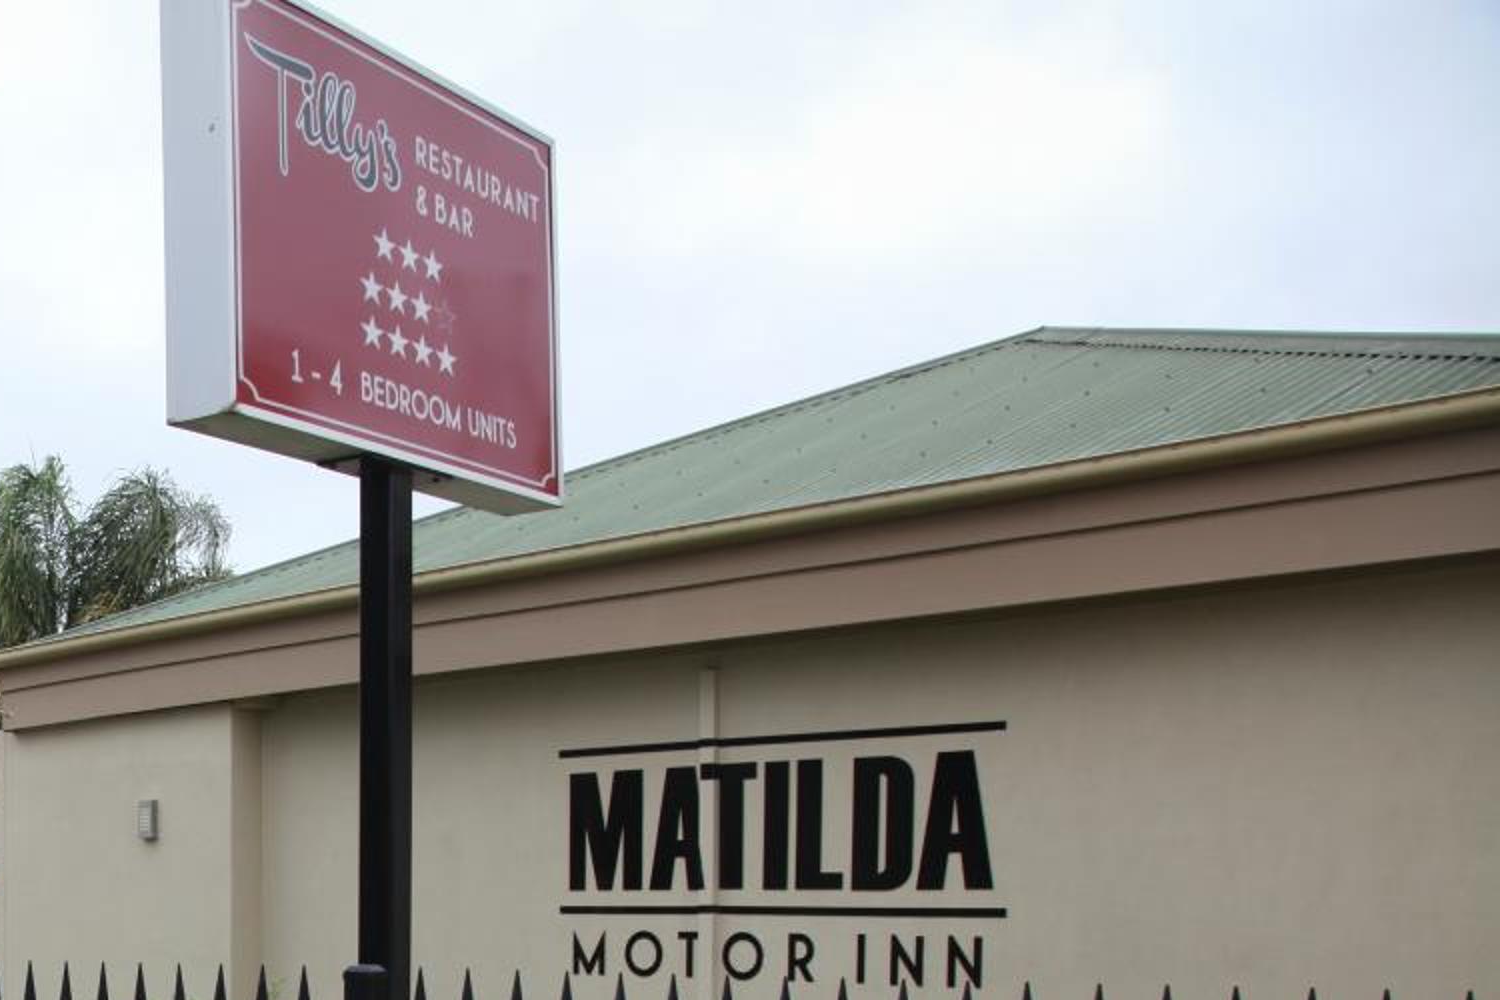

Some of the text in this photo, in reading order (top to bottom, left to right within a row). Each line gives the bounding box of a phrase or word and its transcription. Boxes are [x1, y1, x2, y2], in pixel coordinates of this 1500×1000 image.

[243, 33, 401, 192] Tilly's
[414, 136, 540, 223] RESTAURANT
[416, 185, 474, 237] & BAR
[361, 371, 462, 433] BEDROOM
[467, 407, 517, 449] UNITS
[570, 750, 994, 891] MATILDA
[573, 931, 983, 989] MOTOR INN
